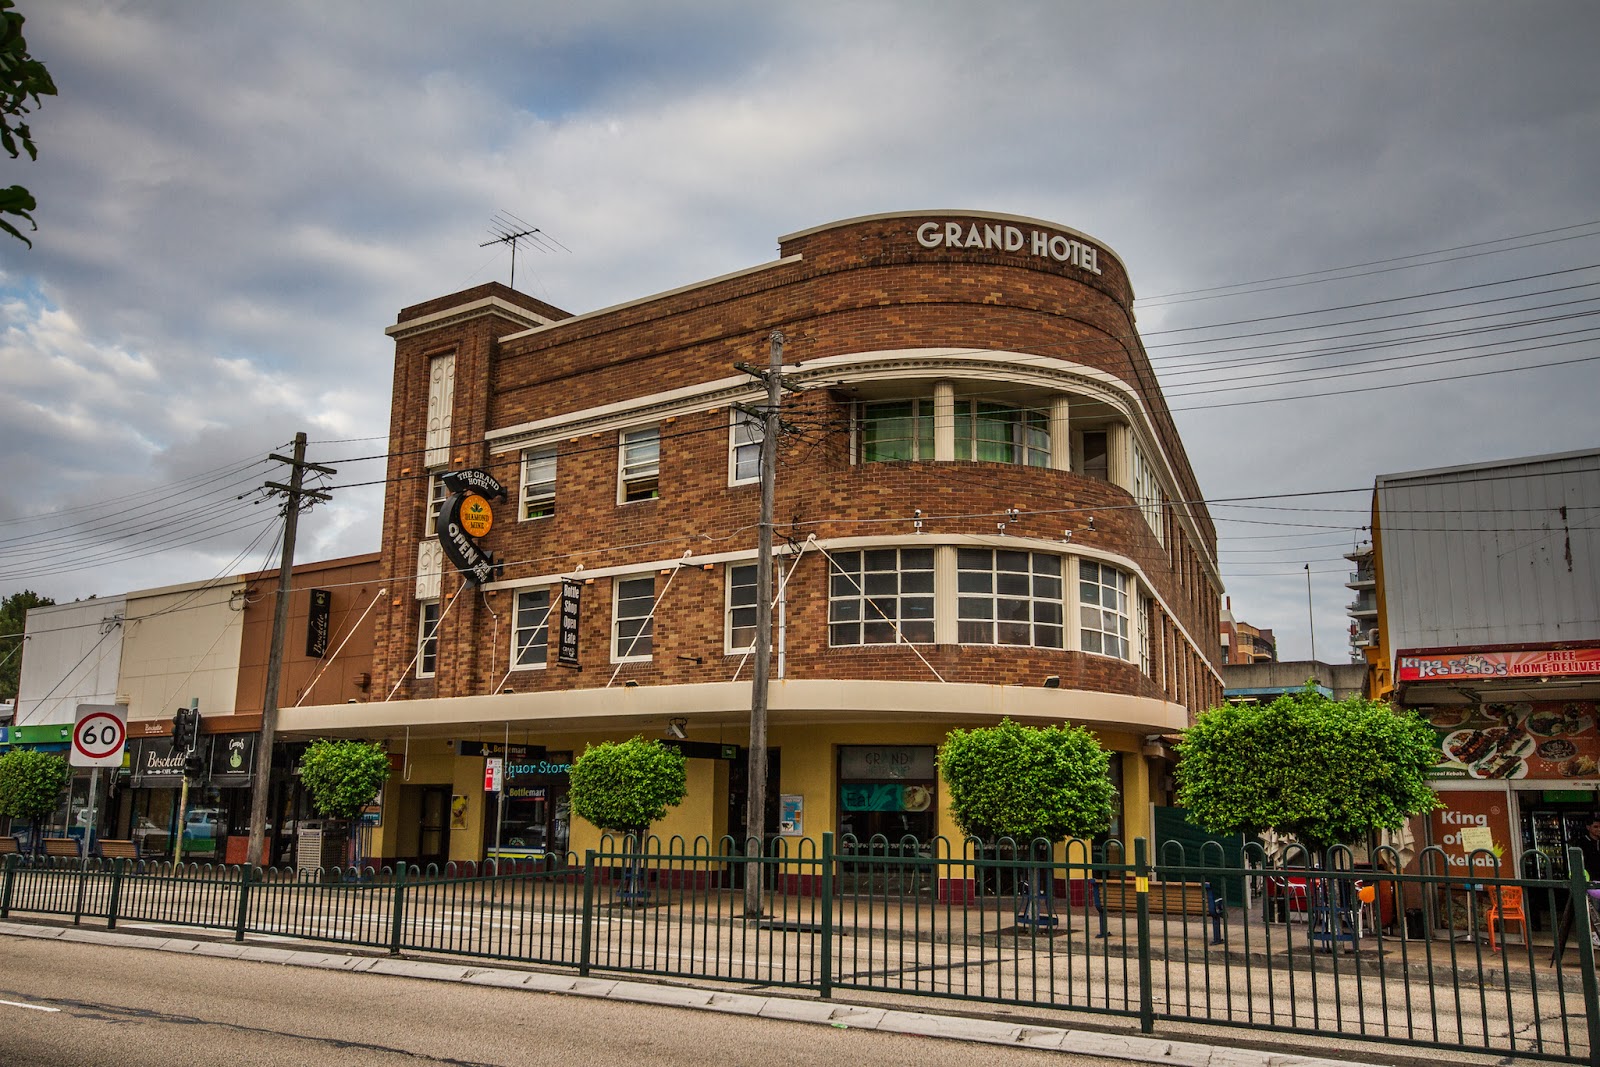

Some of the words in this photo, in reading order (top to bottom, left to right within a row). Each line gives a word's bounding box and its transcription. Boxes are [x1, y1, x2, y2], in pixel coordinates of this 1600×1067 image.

[916, 221, 1024, 252] GRAND
[1030, 230, 1102, 276] HOTEL
[457, 470, 473, 481] THE
[473, 470, 500, 491] GRAND
[468, 478, 489, 490] HOTEL
[465, 513, 490, 522] DIAMOND
[470, 521, 485, 529] MINE
[448, 522, 479, 566] OPEN
[563, 584, 580, 599] Bottle
[564, 599, 578, 616] Shop
[563, 615, 577, 630] Open
[564, 631, 576, 645] Late
[1401, 657, 1442, 669] King
[1447, 658, 1466, 666] of
[1547, 651, 1576, 662] FREE
[1419, 661, 1508, 678] Kebabs
[1513, 663, 1549, 674] HOME
[83, 725, 116, 746] 60
[493, 744, 527, 755] Bottemart
[865, 752, 909, 765] GRND
[504, 762, 537, 778] iquor
[538, 760, 572, 775] Store
[509, 787, 546, 797] Bottlemart
[847, 792, 872, 807] Eat
[1441, 811, 1488, 827] King
[1442, 831, 1463, 845] of
